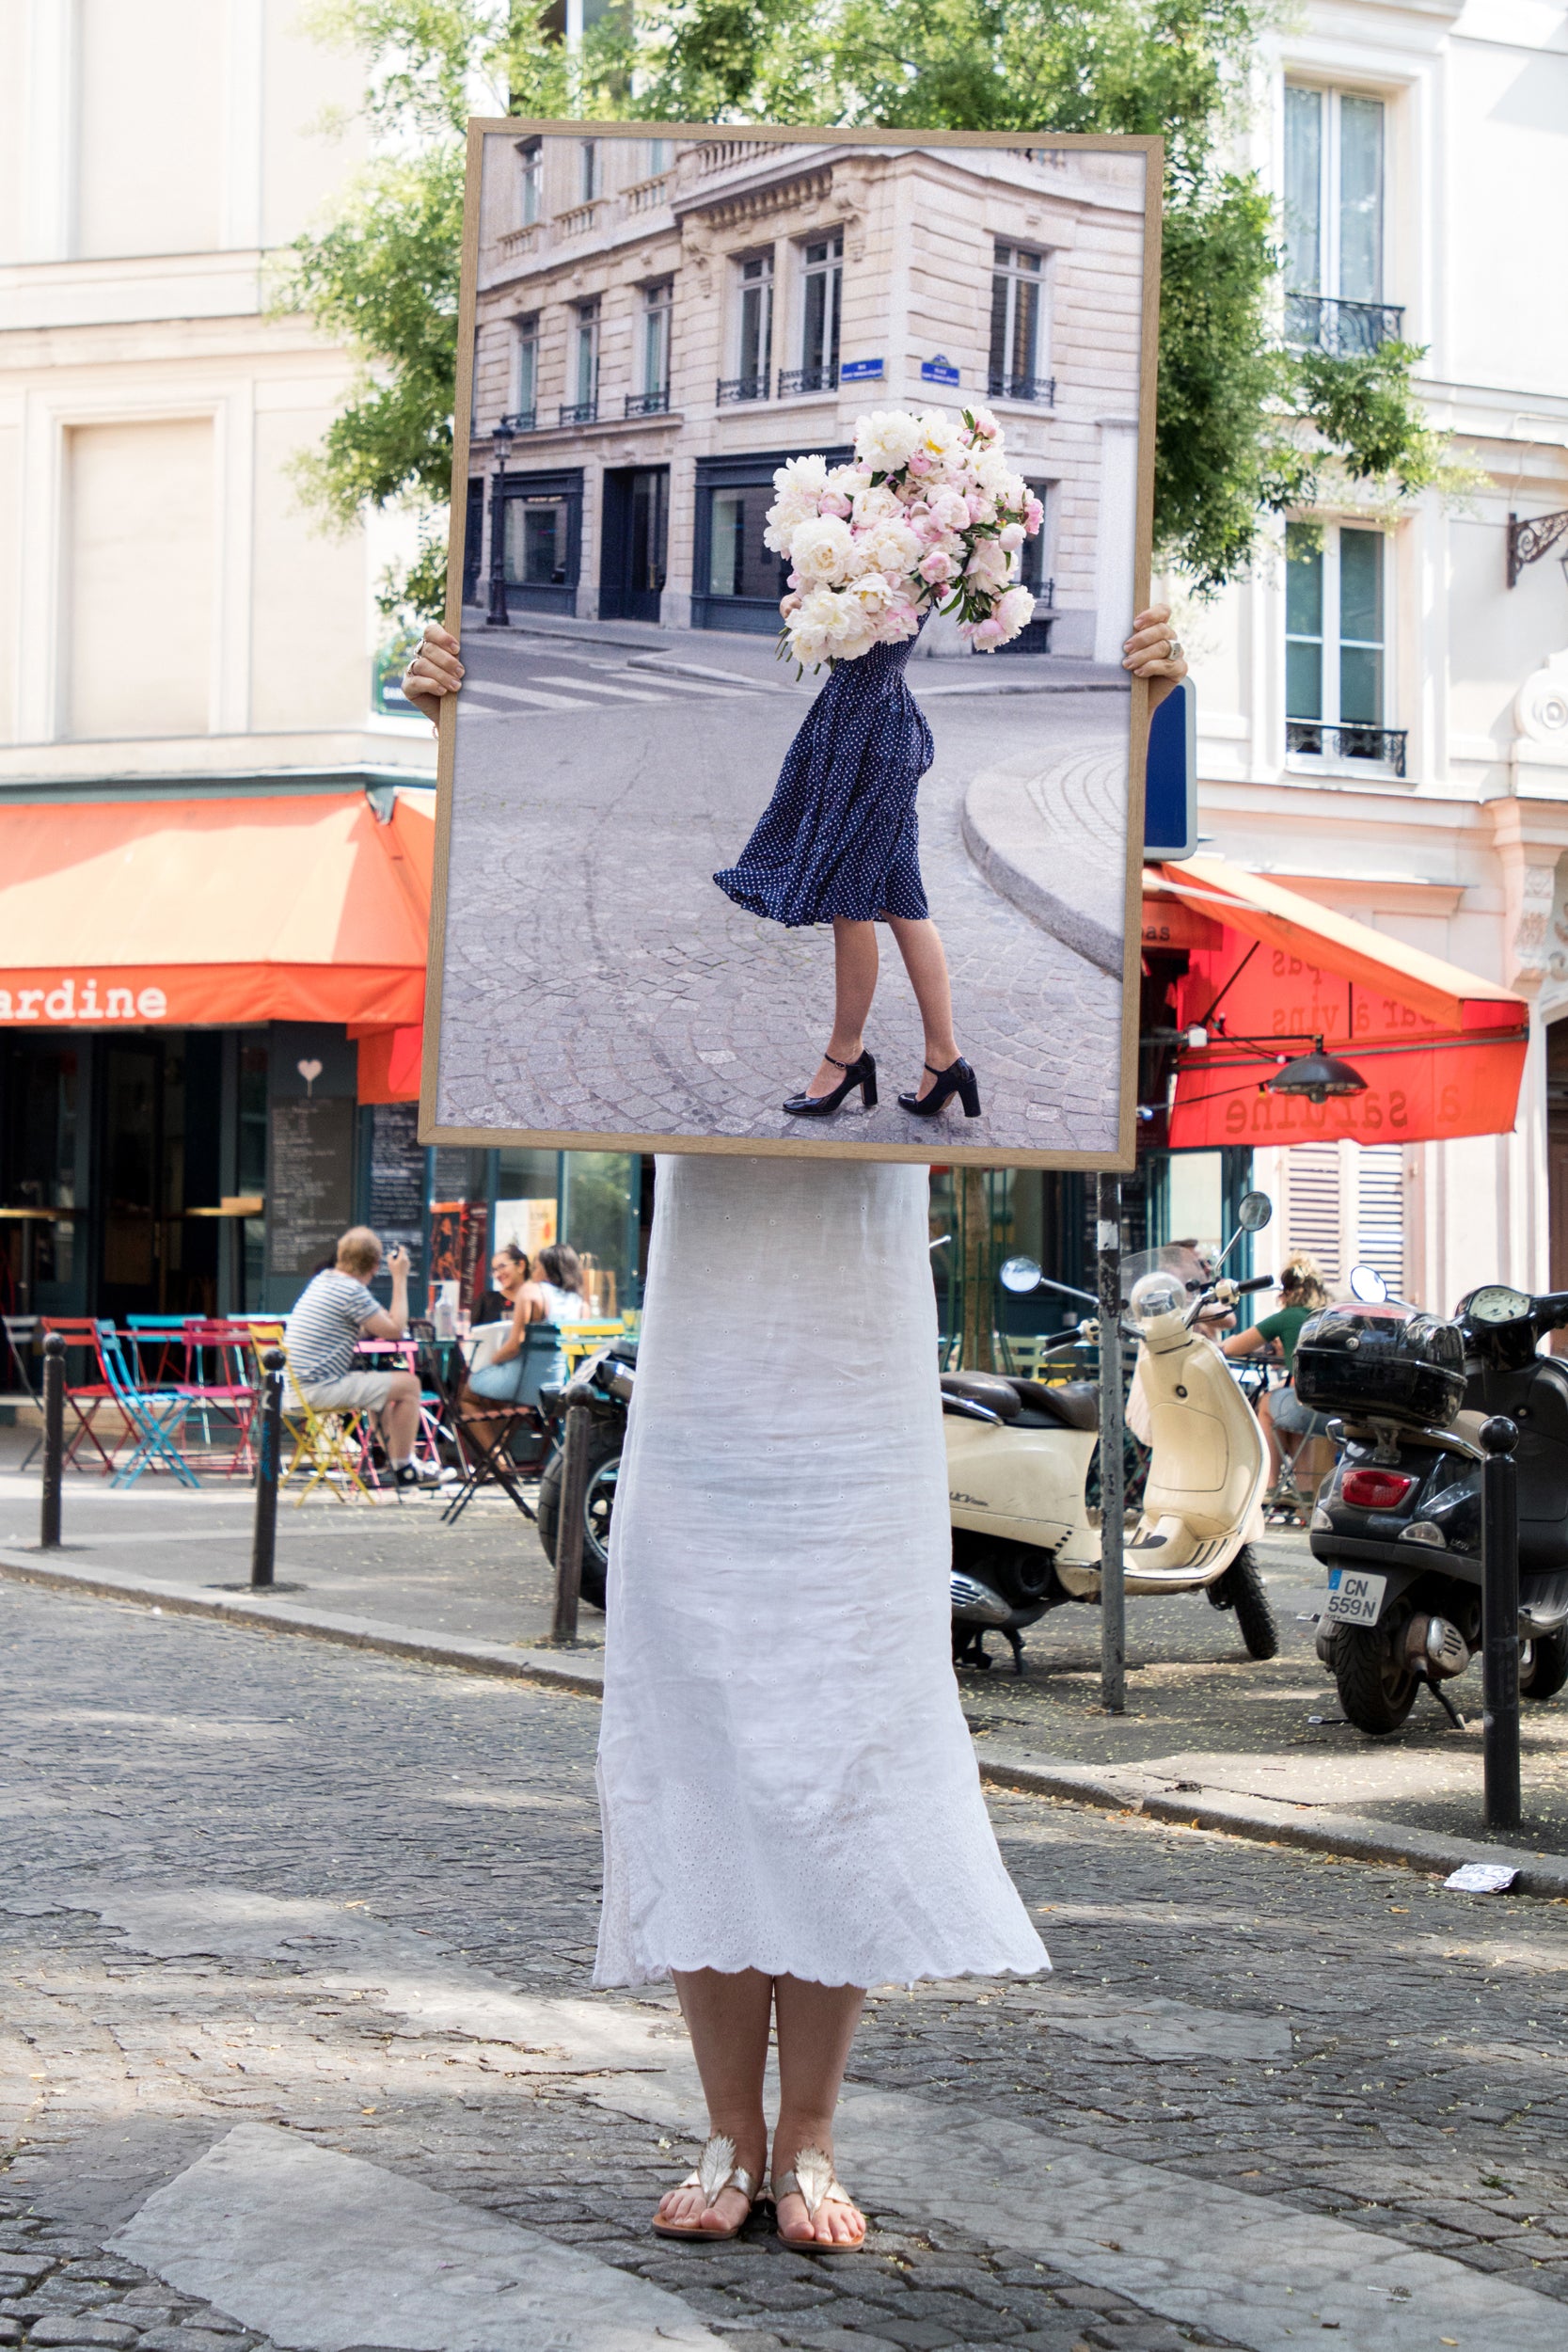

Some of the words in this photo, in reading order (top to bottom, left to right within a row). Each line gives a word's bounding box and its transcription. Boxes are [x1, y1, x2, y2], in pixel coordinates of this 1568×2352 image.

[1142, 926, 1170, 942] as
[0, 978, 167, 1020] ardine
[1344, 1579, 1369, 1597] CN
[1328, 1596, 1376, 1618] 559N
